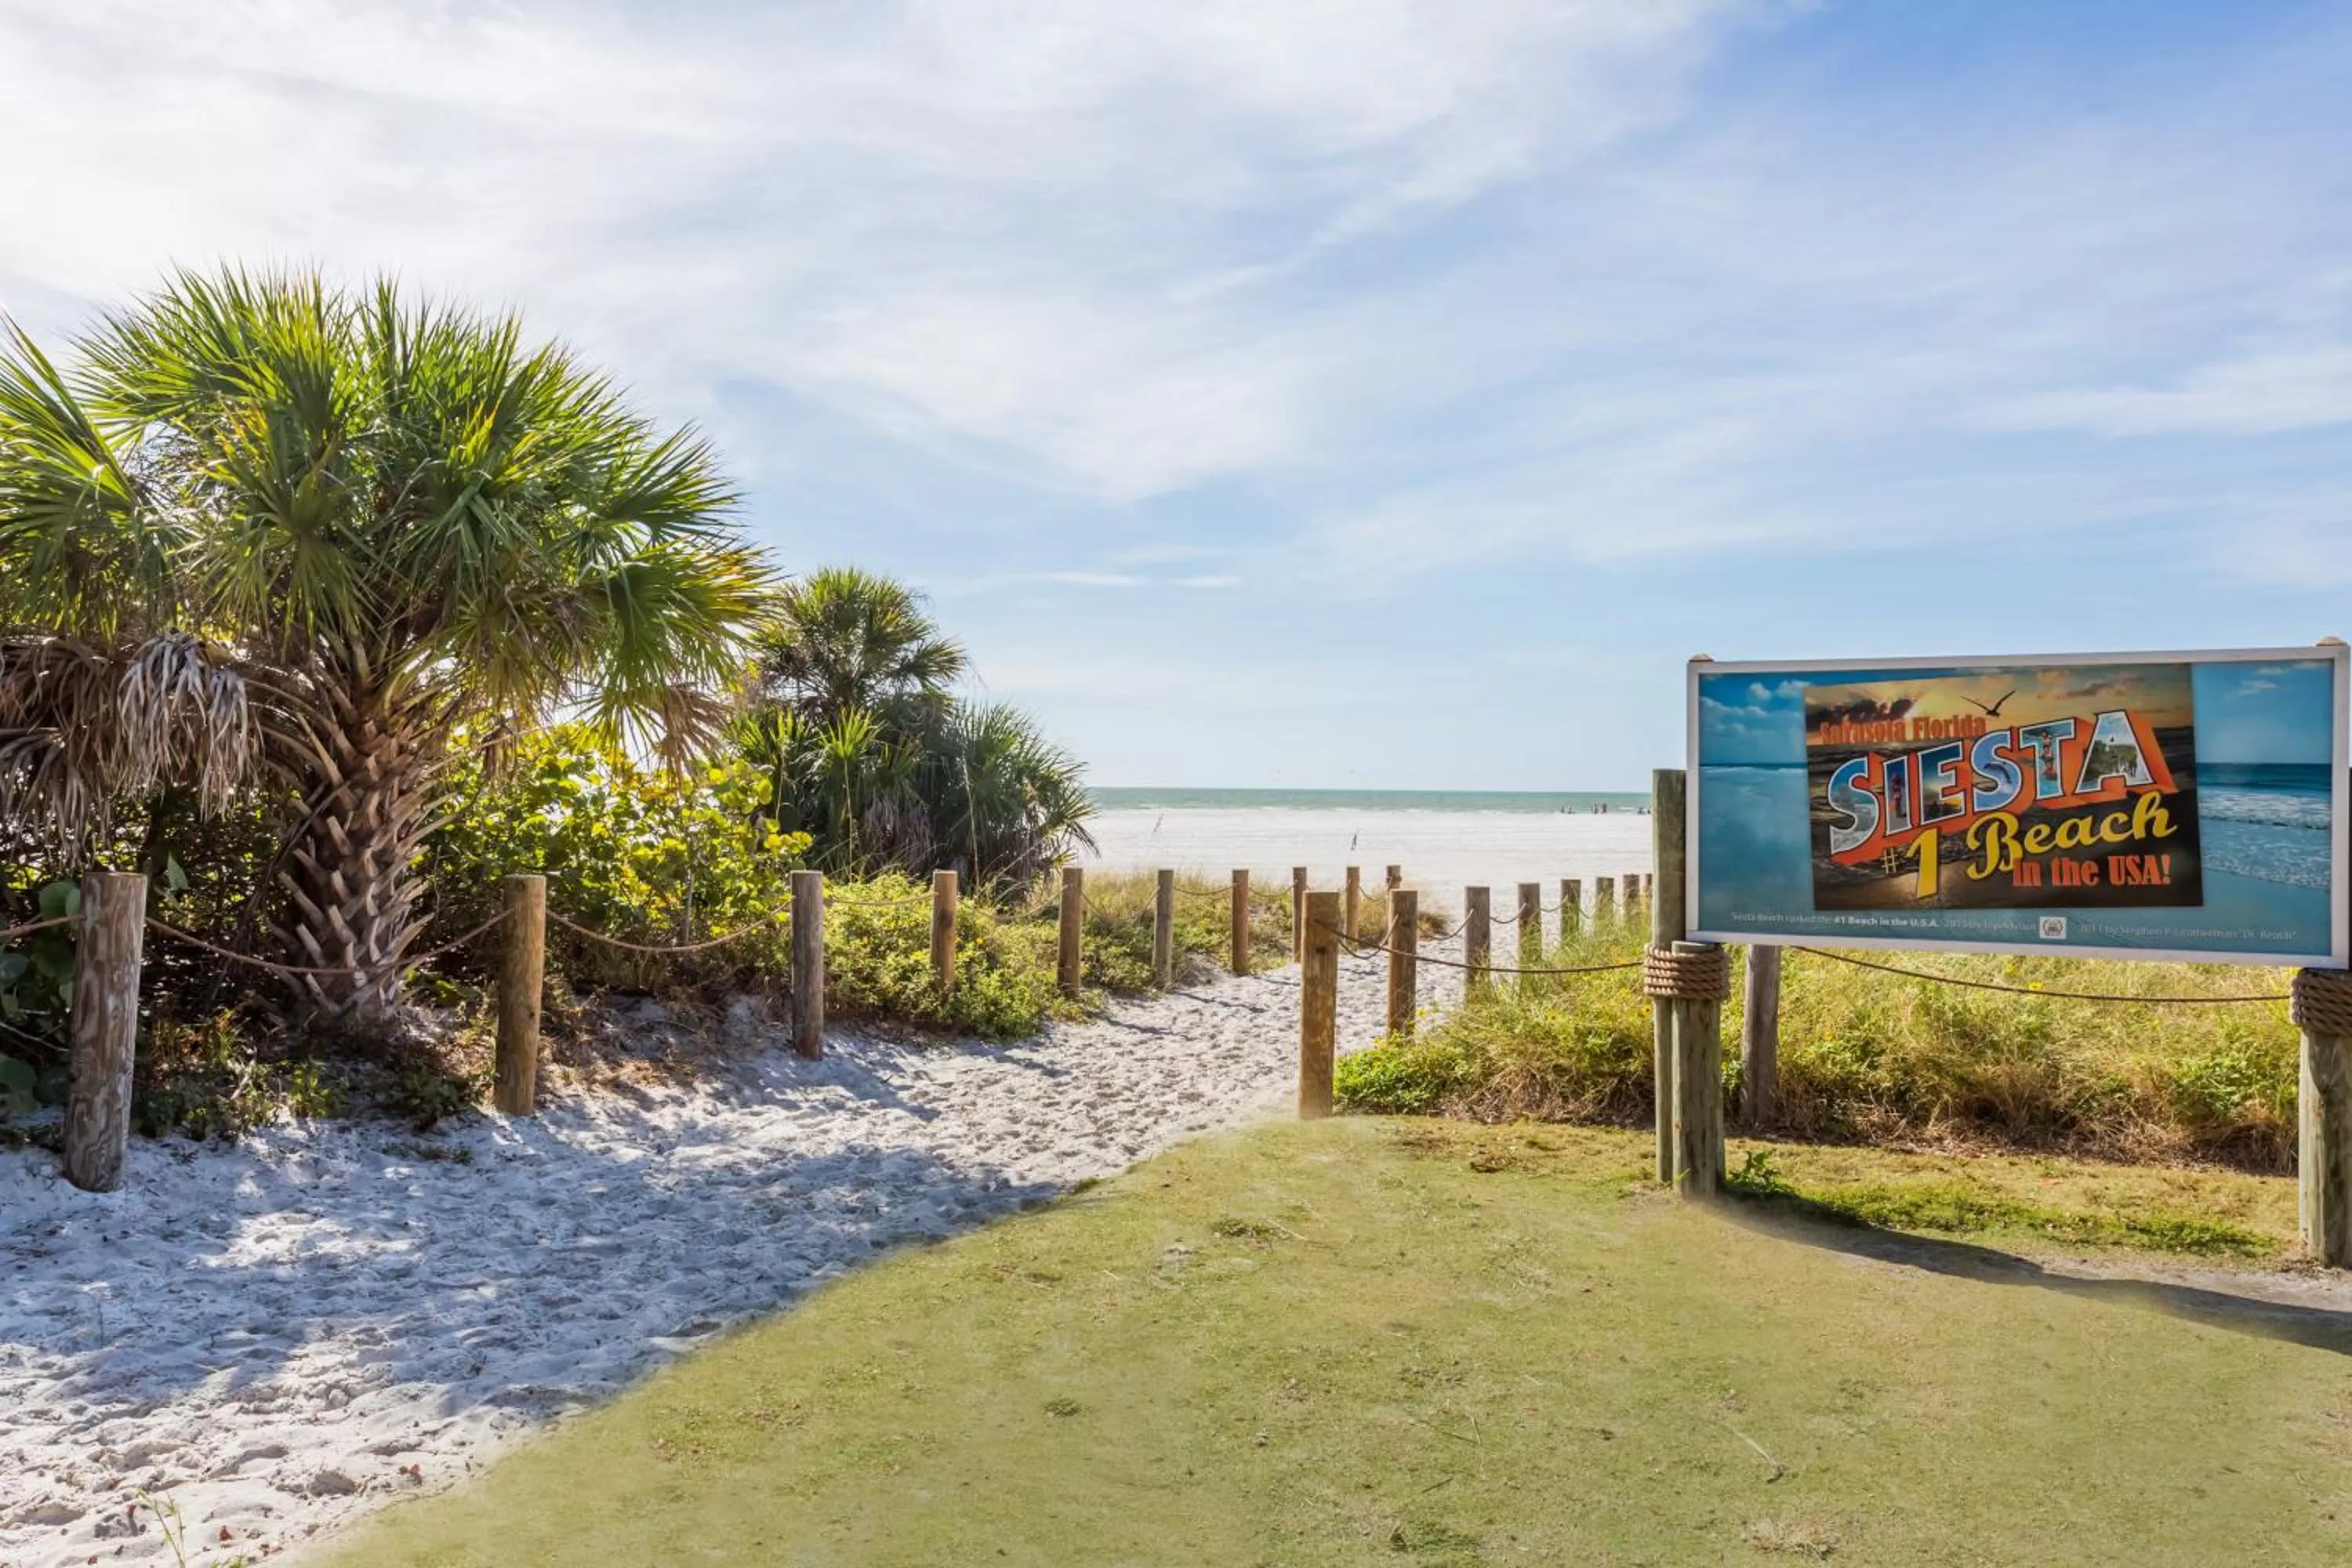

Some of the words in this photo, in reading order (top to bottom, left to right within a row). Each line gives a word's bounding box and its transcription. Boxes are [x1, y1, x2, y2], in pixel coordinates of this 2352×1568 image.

[1913, 714, 1987, 741] Florida
[1826, 707, 2158, 858] SIESTA
[1965, 790, 2179, 880] Beach
[2012, 858, 2042, 887] in
[2051, 858, 2100, 887] the
[2107, 853, 2172, 886] USA!
[1848, 915, 1878, 926] Beach
[1879, 916, 1890, 926] in
[1891, 916, 1908, 927] the
